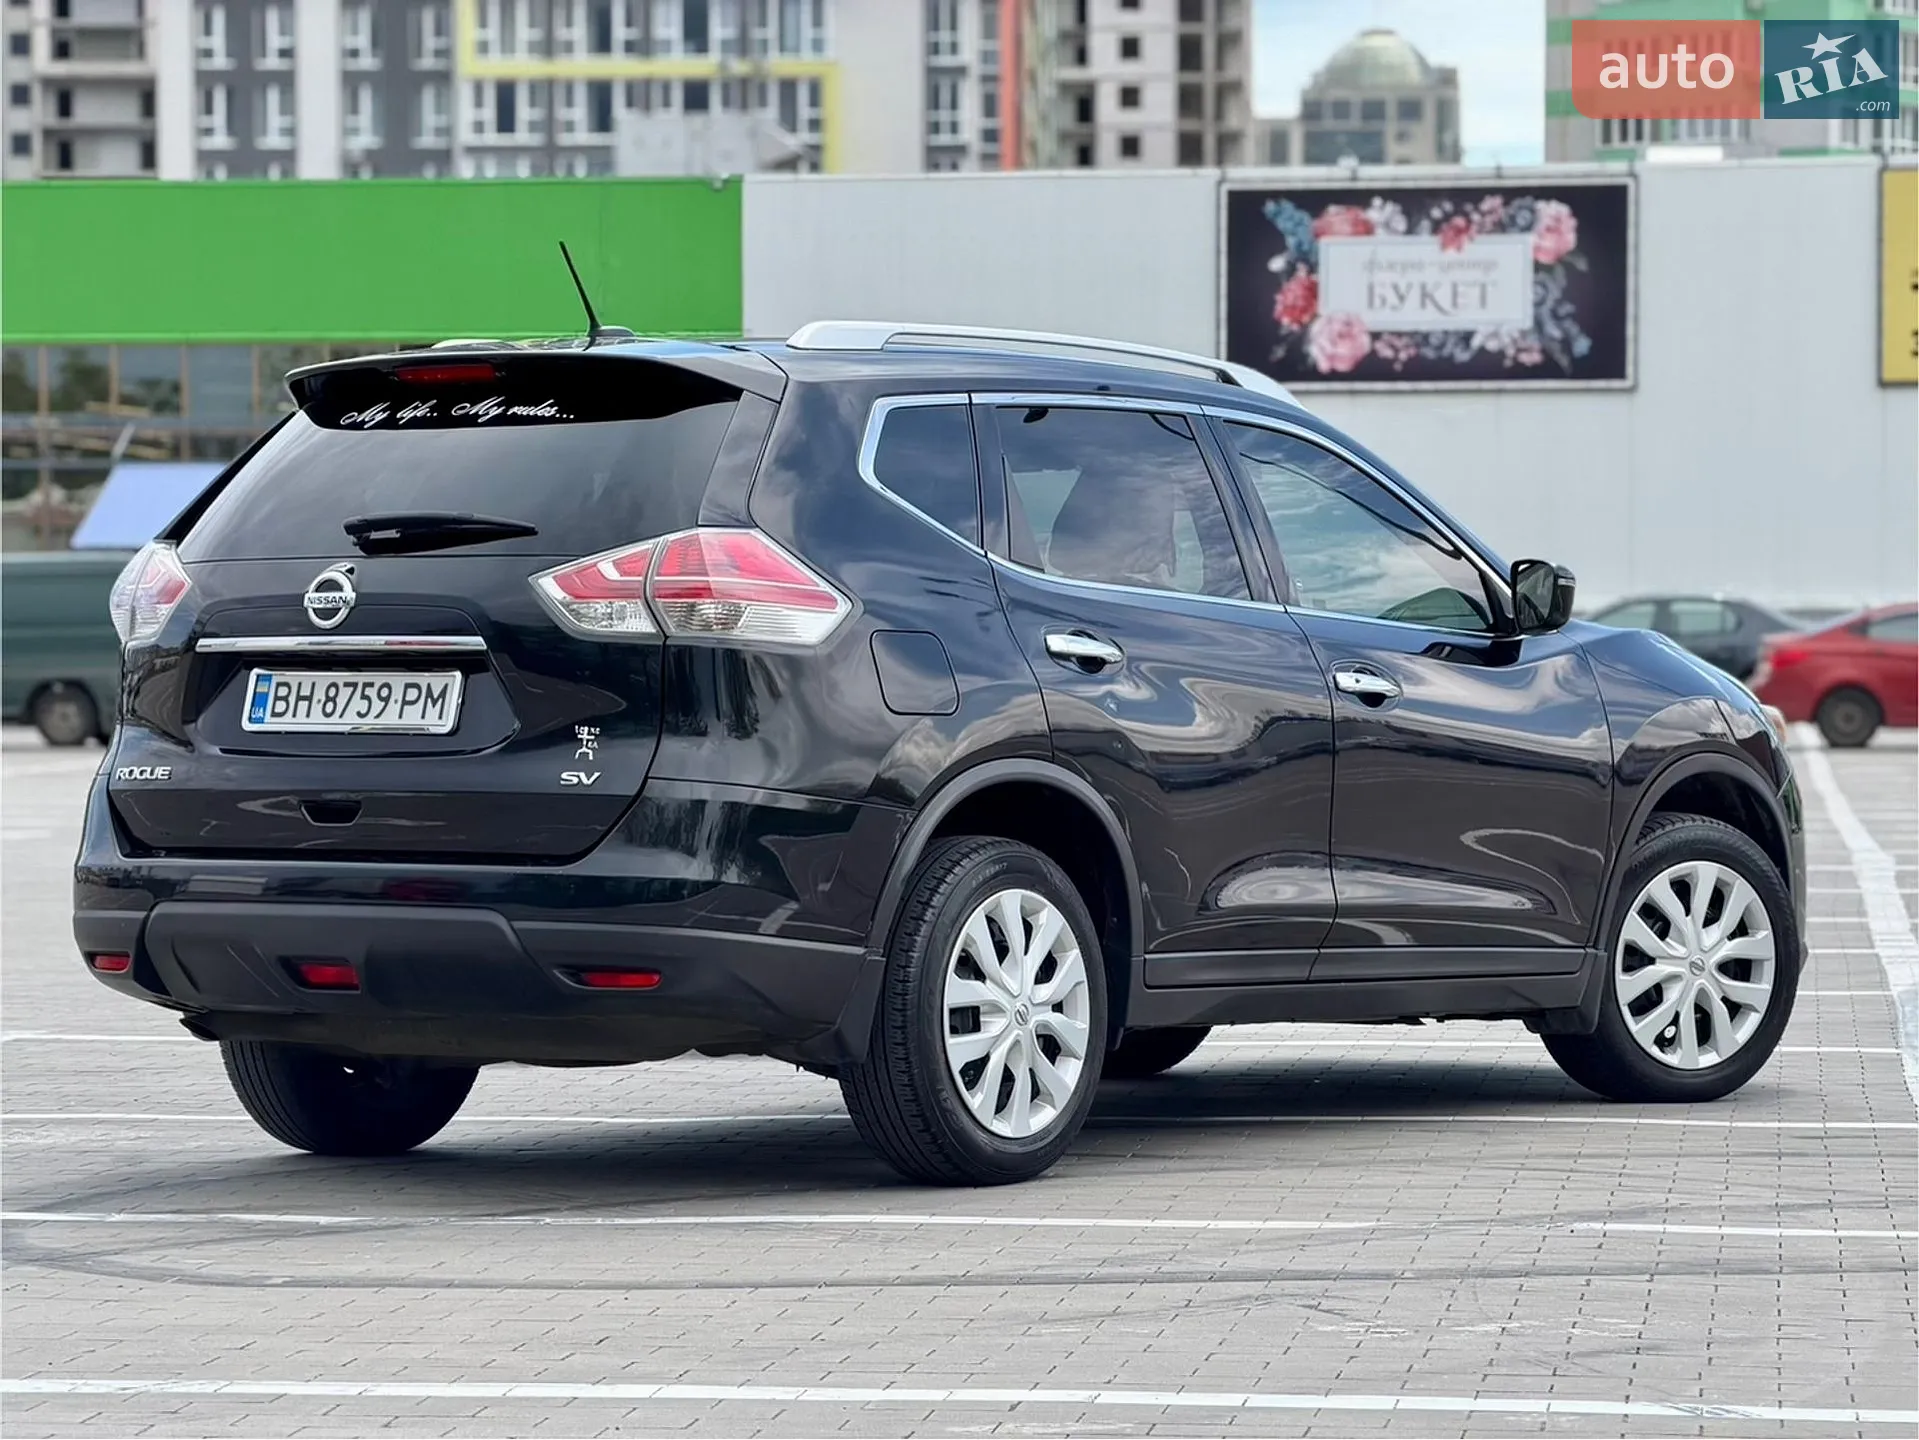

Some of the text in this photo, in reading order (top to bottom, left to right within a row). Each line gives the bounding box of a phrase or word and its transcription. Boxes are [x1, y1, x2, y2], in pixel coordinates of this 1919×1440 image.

[1366, 280, 1498, 317] БУКЕТ
[340, 401, 391, 428] My
[450, 395, 506, 422] My
[307, 595, 348, 605] NISSAN
[250, 706, 265, 719] UA
[115, 766, 172, 780] ROGUE
[560, 771, 602, 785] SV
